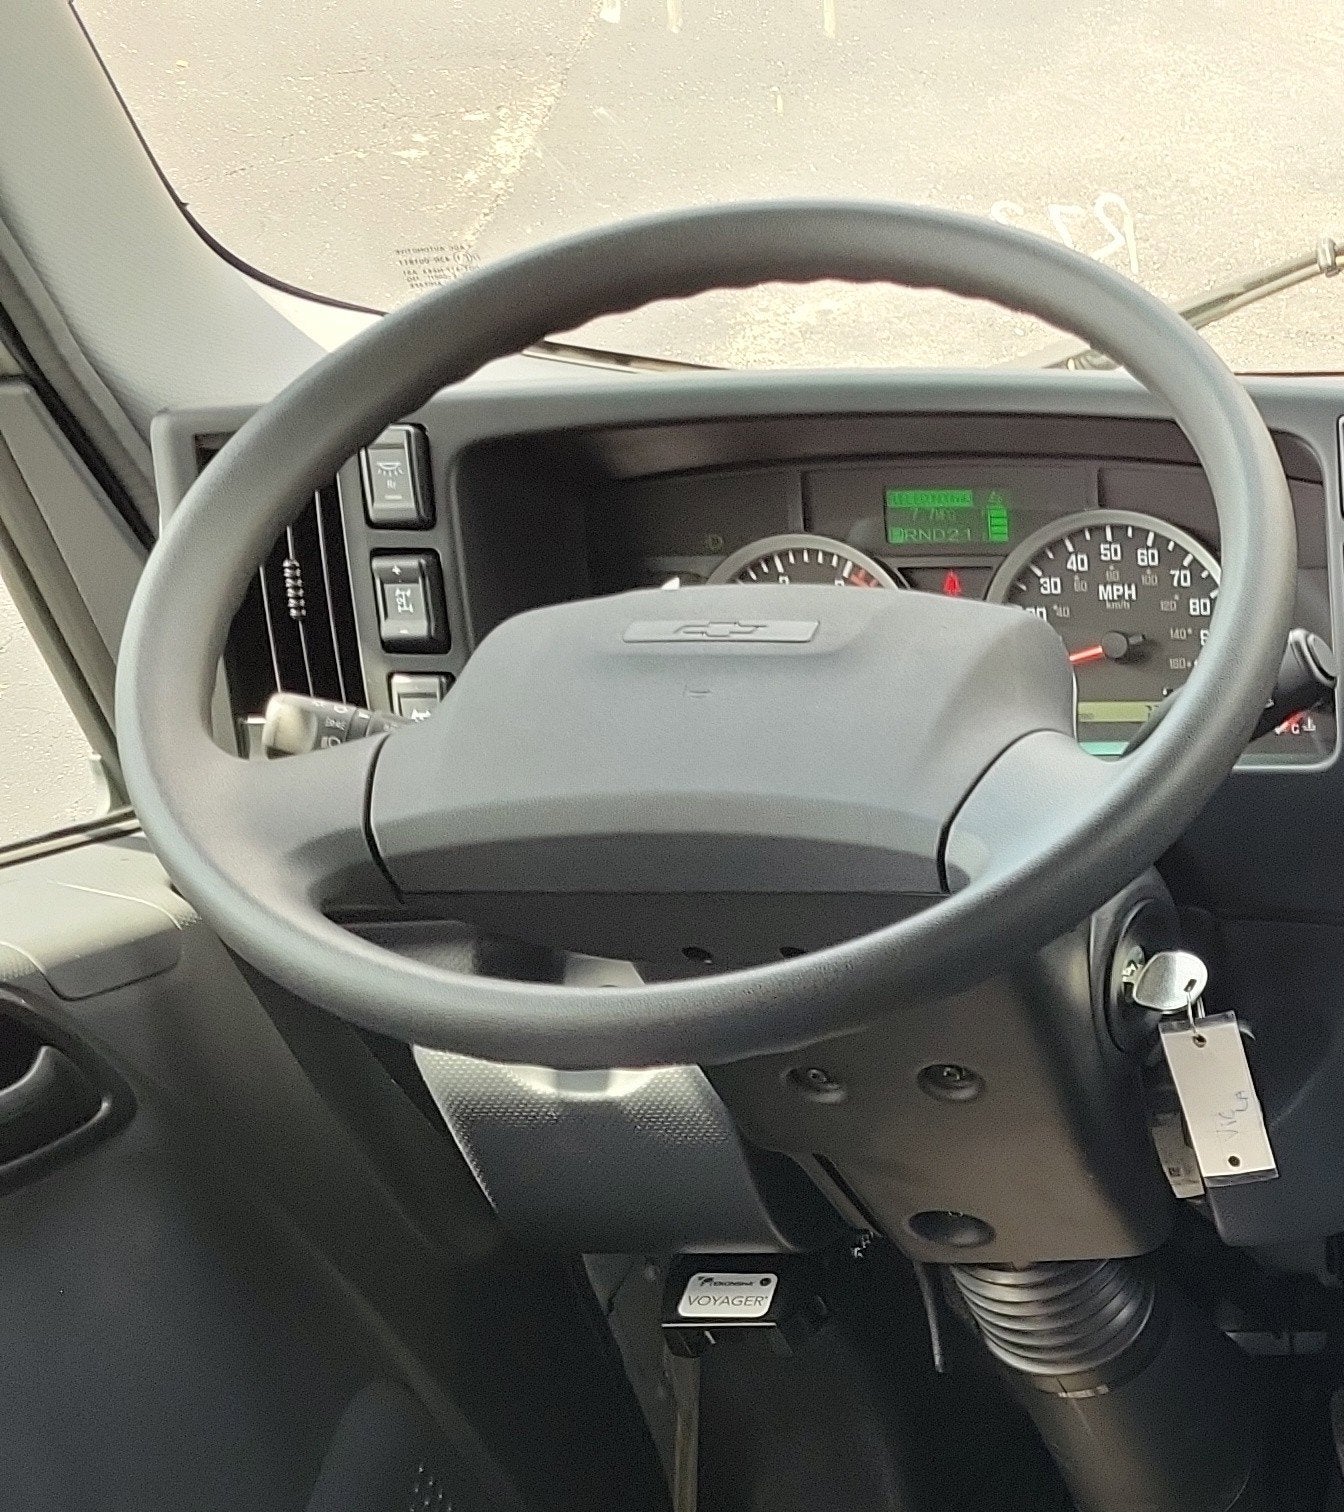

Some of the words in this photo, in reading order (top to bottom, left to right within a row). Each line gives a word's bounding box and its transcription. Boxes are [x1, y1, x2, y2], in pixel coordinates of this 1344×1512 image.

[1100, 543, 1121, 560] 50
[1137, 548, 1158, 566] 60
[1067, 553, 1088, 571] 40
[1040, 577, 1061, 594] 30
[1170, 569, 1190, 587] 70
[1099, 584, 1136, 600] MPH
[1190, 598, 1210, 615] 80
[1291, 724, 1299, 734] C
[688, 1295, 764, 1306] VOYAGER
